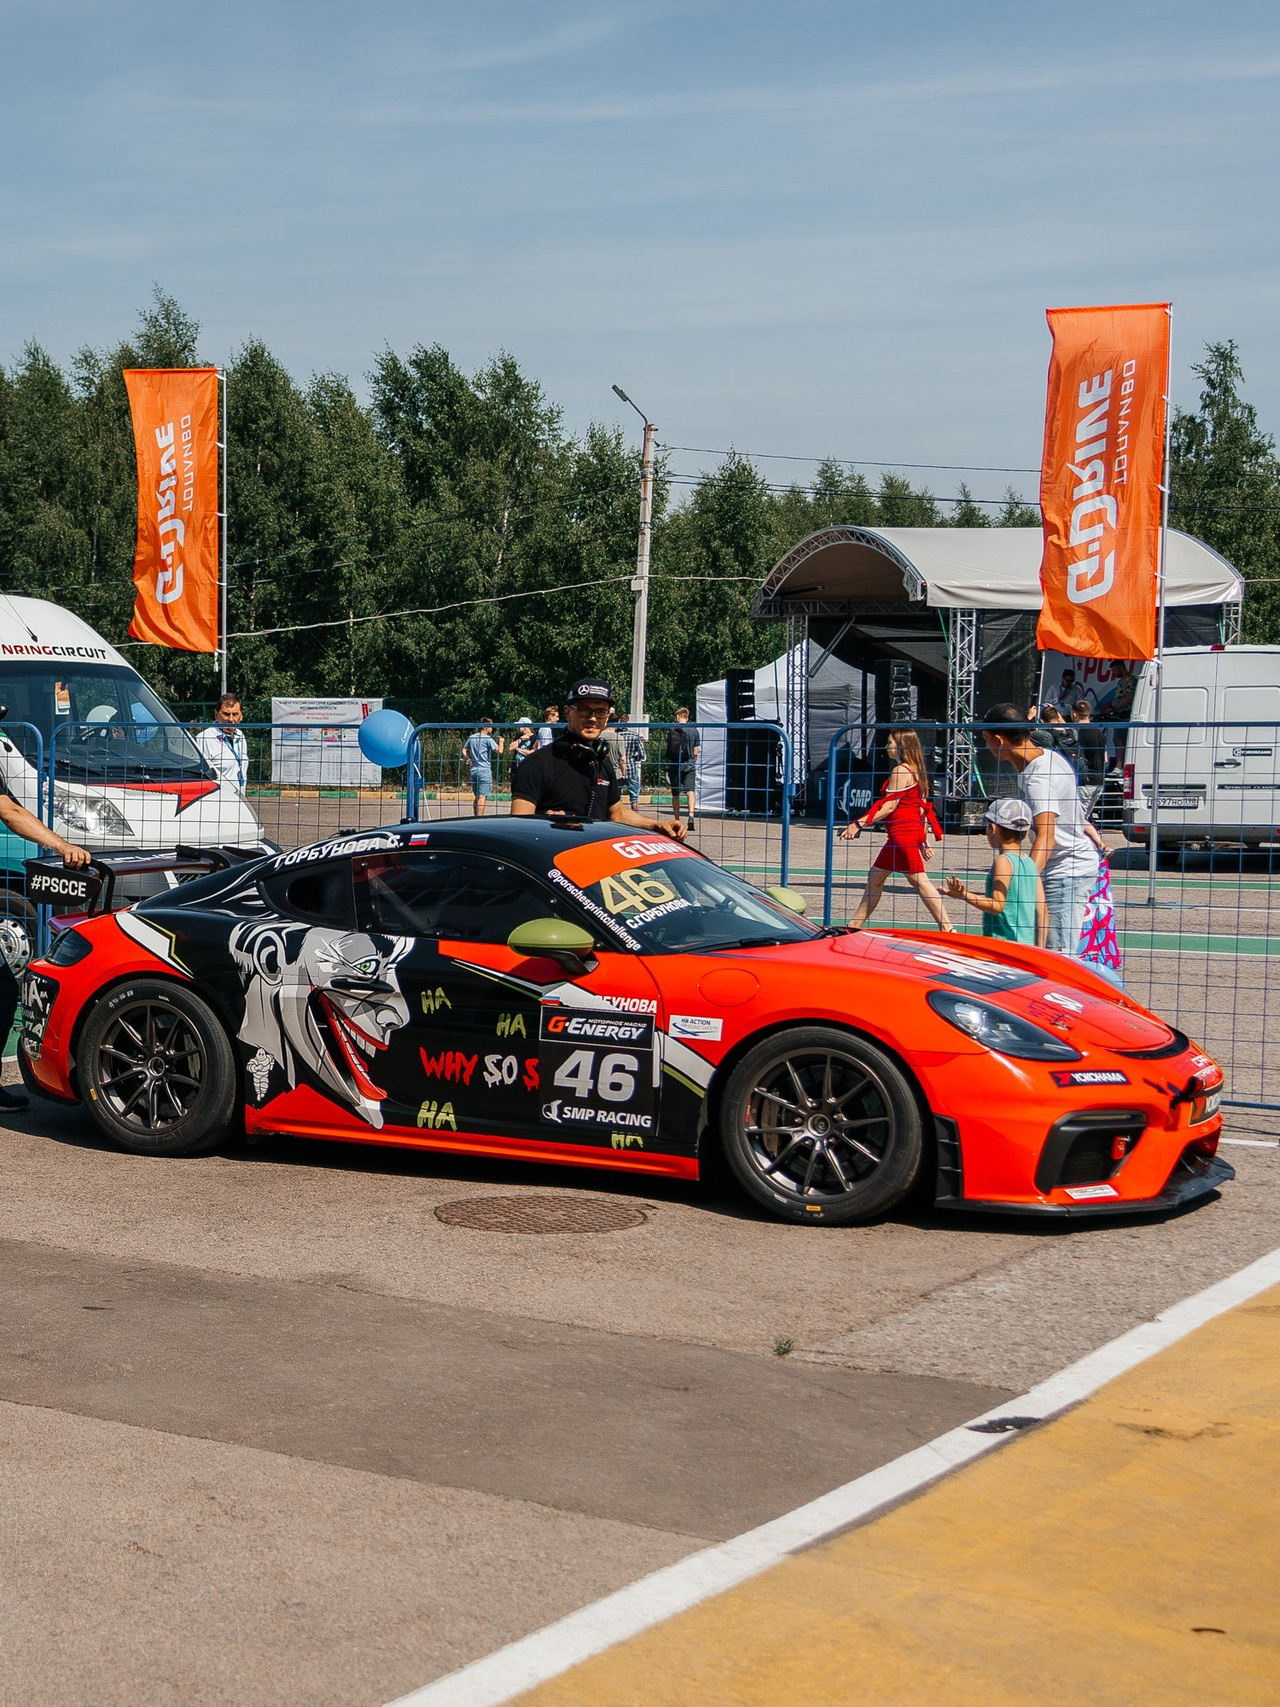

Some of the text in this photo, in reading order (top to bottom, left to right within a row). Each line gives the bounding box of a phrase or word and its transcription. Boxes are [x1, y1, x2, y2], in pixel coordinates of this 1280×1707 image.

[849, 788, 871, 808] SMP
[274, 837, 380, 868] ГОРБУНОВА
[31, 874, 87, 897] #PSCCE
[600, 868, 675, 915] 46
[547, 868, 642, 950] @porschesprintchallenge
[421, 987, 452, 1014] HA
[496, 1013, 526, 1039] HA
[419, 1046, 478, 1086] WHY
[553, 1049, 639, 1102] 46
[1071, 1072, 1126, 1083] YOKOHAMA
[417, 1100, 457, 1131] HA
[563, 1106, 652, 1128] SMP RACING
